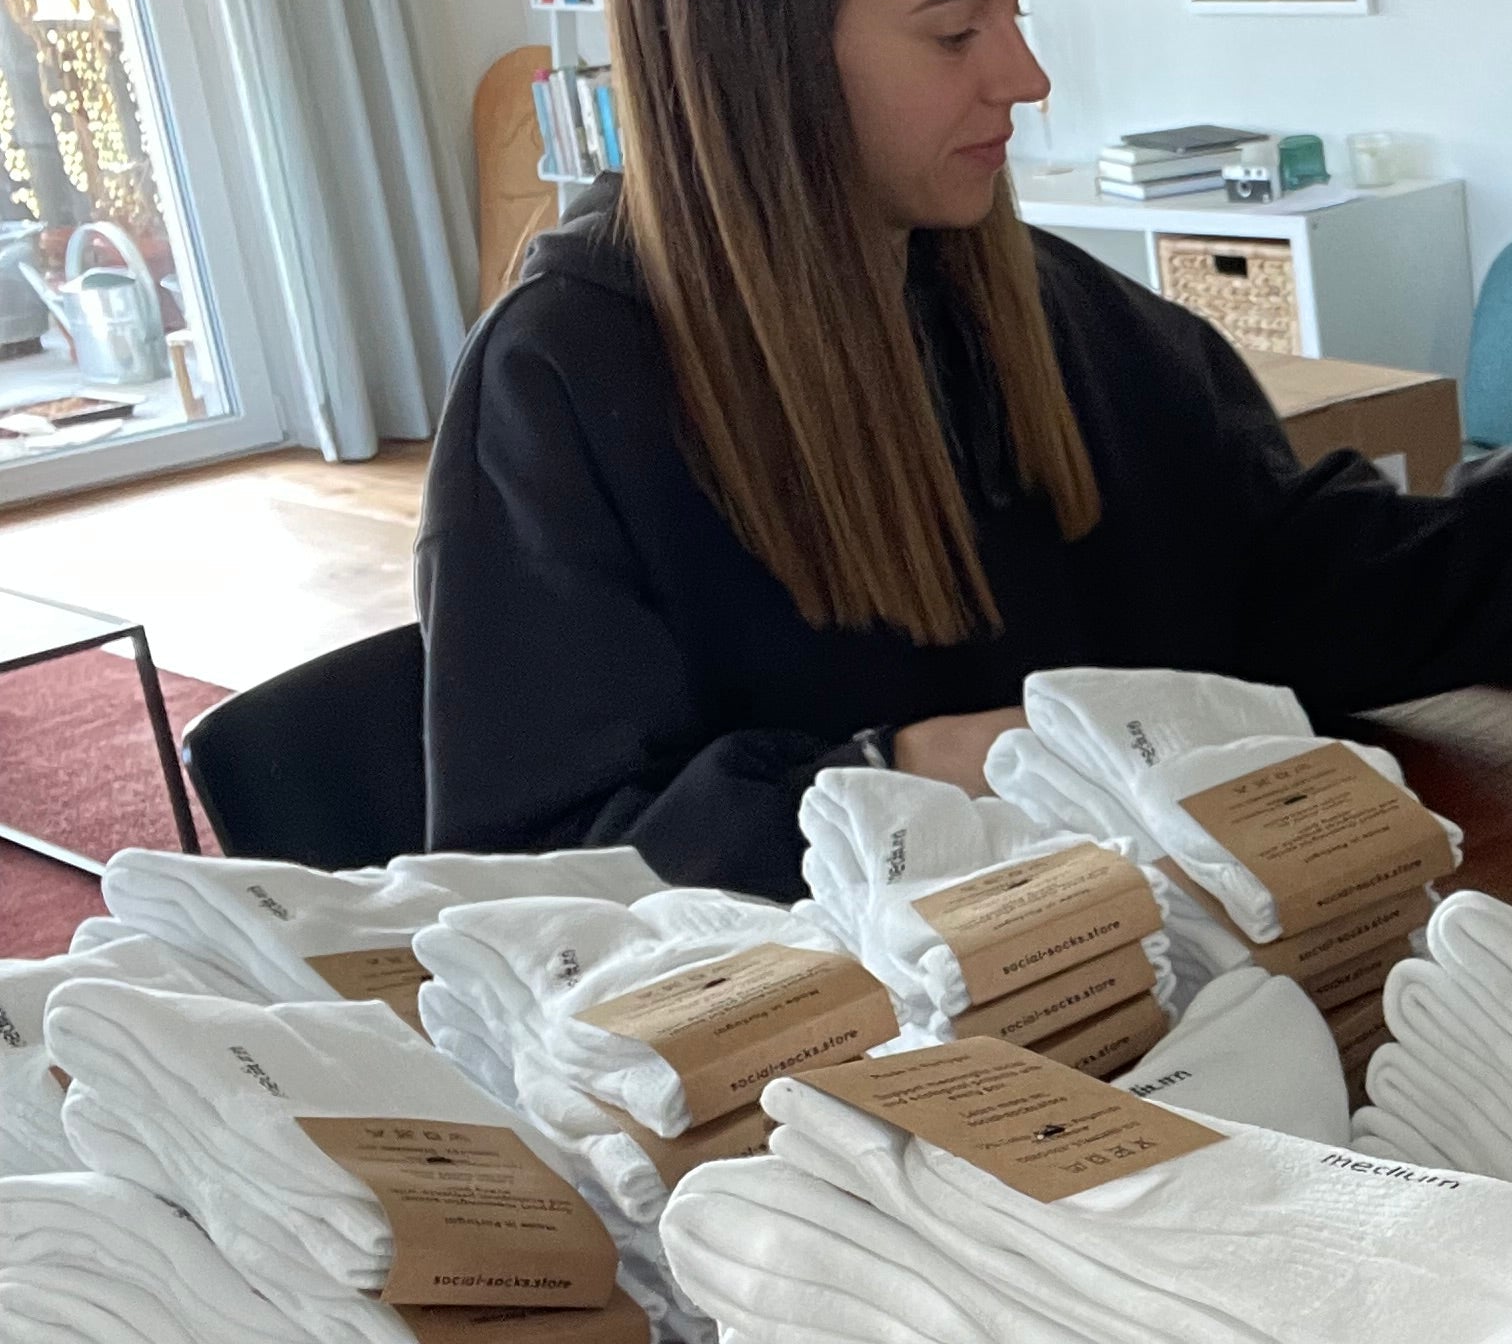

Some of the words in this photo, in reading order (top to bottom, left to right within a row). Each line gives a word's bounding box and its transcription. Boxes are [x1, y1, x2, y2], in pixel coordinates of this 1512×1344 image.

[1003, 920, 1120, 975] social-socks.store
[730, 1028, 858, 1092] social-socks.store
[1320, 1154, 1460, 1190] medium
[433, 1274, 573, 1290] social-socks.store
